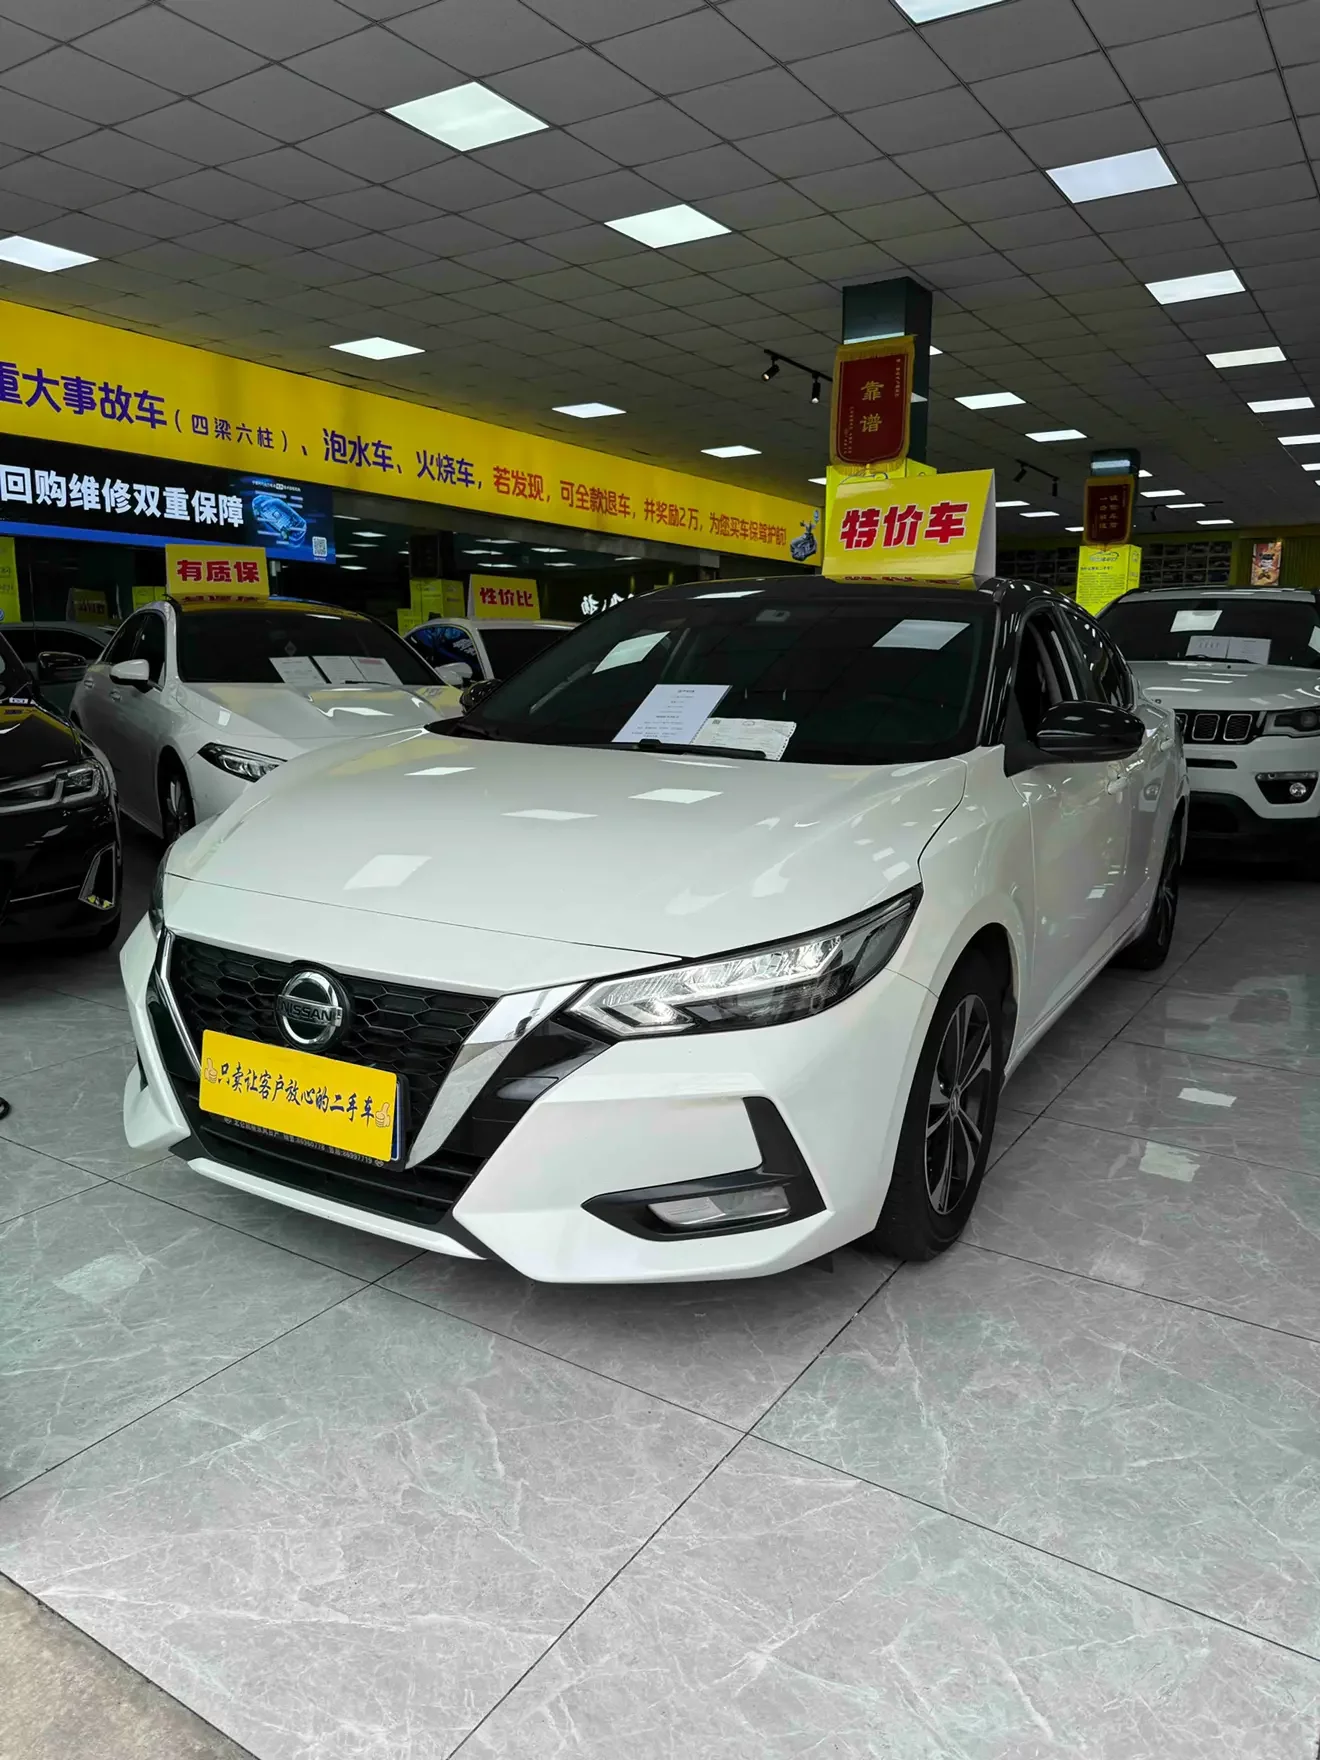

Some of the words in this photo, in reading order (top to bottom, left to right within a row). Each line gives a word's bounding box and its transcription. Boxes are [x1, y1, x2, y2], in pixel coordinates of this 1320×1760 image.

[860, 380, 885, 433] 靠谱
[0, 464, 244, 528] 回购维修双重保障
[839, 500, 970, 551] 特价车
[176, 559, 260, 583] 有质保
[479, 586, 535, 608] 性价比
[280, 999, 333, 1022] NISSAN
[217, 1061, 375, 1128] 只卖让客户放心的二手车
